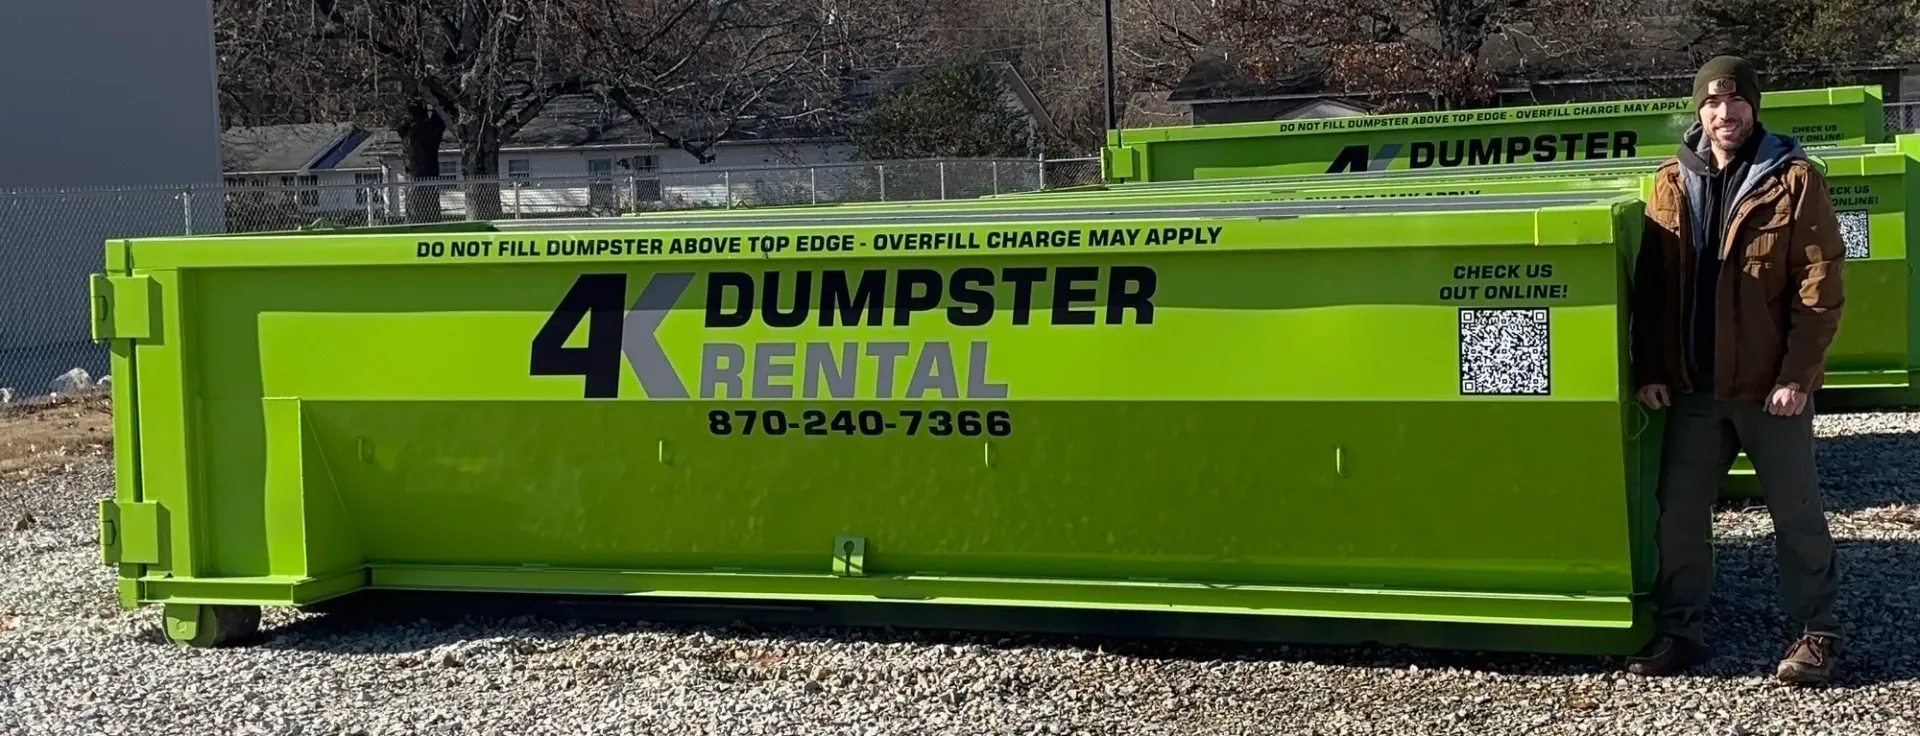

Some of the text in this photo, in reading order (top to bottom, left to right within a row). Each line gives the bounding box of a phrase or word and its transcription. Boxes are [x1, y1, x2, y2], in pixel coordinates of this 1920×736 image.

[1280, 124, 1295, 132] DO
[1298, 122, 1320, 132] NOT
[1322, 120, 1346, 130] FILL
[1348, 118, 1408, 129] DUMPSTER
[1412, 114, 1449, 125] ABOVE
[1452, 113, 1474, 122] TOP
[1476, 112, 1507, 121] EDGE
[1516, 107, 1570, 119] OVERFILL
[1573, 104, 1621, 116] CHARGE
[1624, 103, 1650, 113] MAY
[1652, 100, 1690, 112] APPLY
[1792, 124, 1838, 134] CHECK US
[1409, 130, 1638, 169] DUMPSTER
[1829, 185, 1870, 194] ECK US
[416, 242, 444, 258] DO
[450, 240, 492, 257] NOT
[498, 240, 540, 257] FILL
[546, 238, 663, 256] DUMPSTER
[668, 236, 741, 254] ABOVE
[748, 236, 790, 253] TOP
[796, 234, 855, 252] EDGE
[873, 232, 980, 251] OVERFILL
[986, 230, 1081, 249] CHARGE
[1088, 228, 1141, 248] MAY
[1144, 226, 1223, 246] APPLY
[1453, 264, 1553, 280] CHECK US
[703, 265, 1157, 329] DUMPSTER
[1439, 284, 1568, 300] OUT ONLINE!
[529, 272, 697, 399] 4K
[700, 339, 1009, 399] RENTAL
[708, 410, 1012, 437] 870-240-7366
